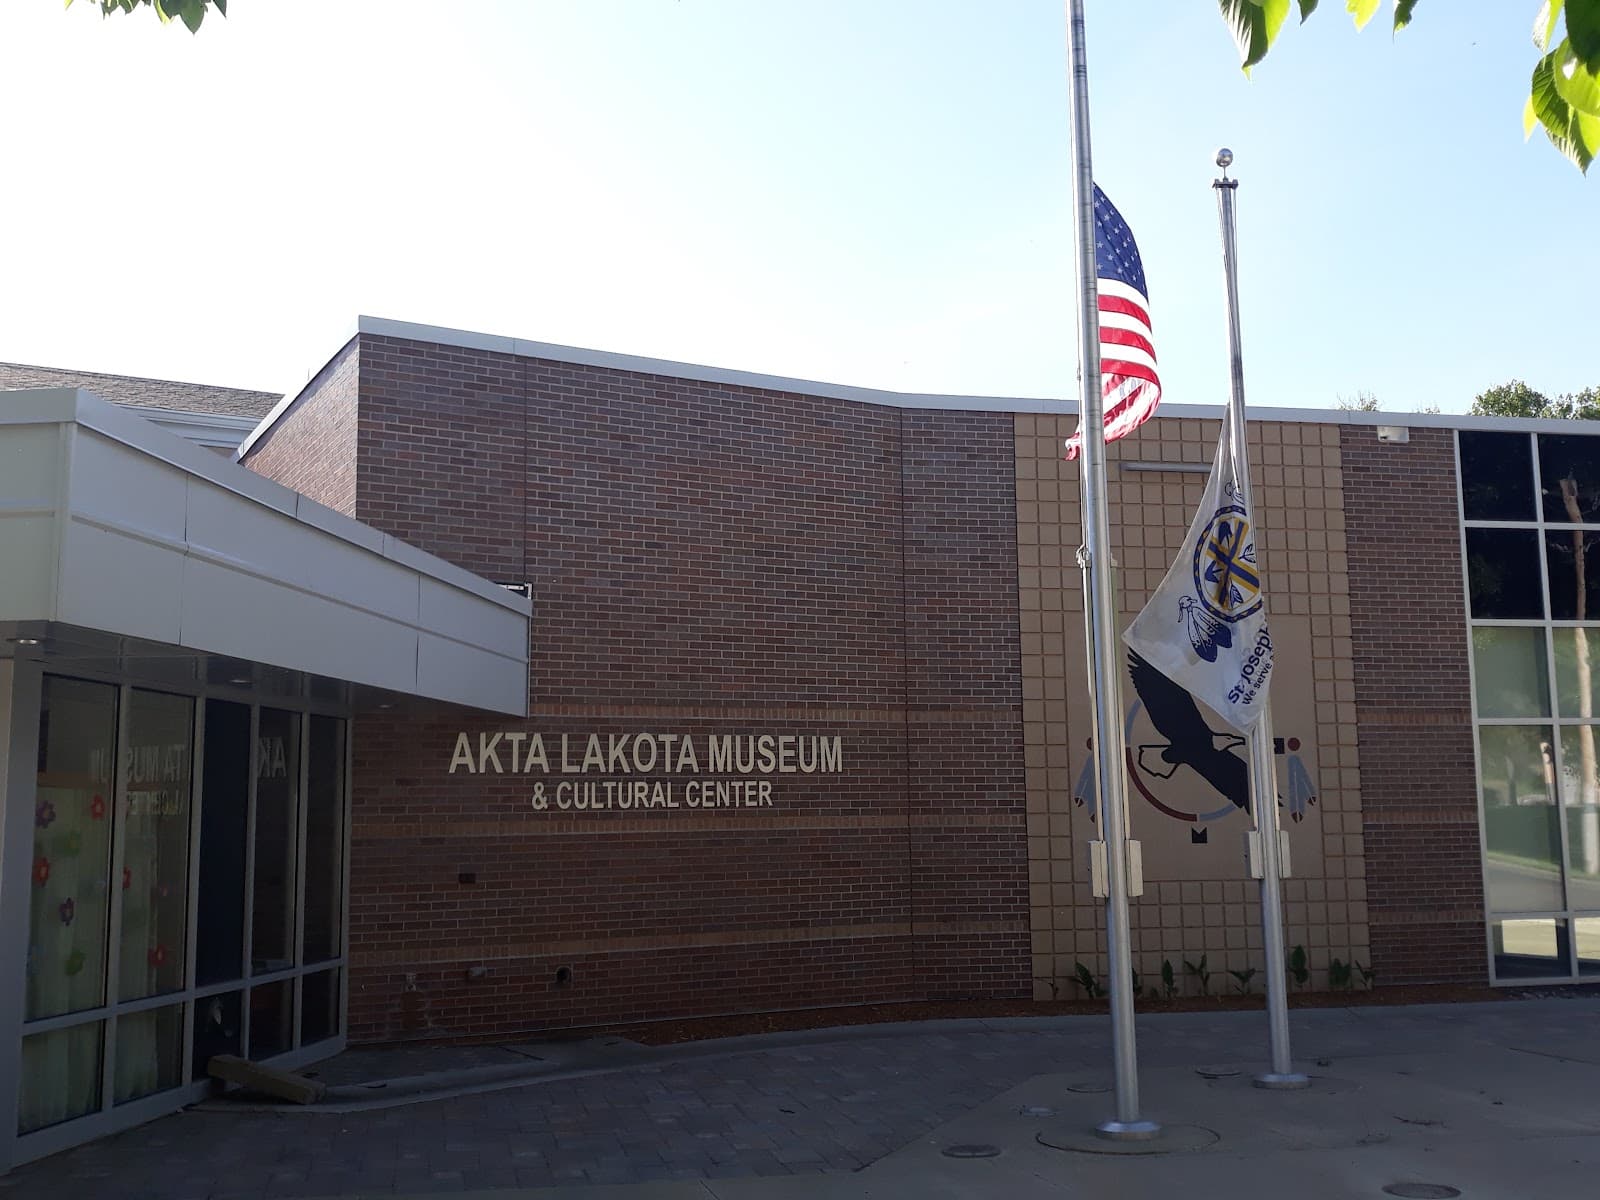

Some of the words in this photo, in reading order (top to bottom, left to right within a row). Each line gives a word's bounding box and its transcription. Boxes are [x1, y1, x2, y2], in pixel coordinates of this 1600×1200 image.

[1242, 690, 1257, 705] We
[1253, 662, 1273, 689] serve
[448, 731, 550, 774] AKTA
[561, 732, 699, 774] LAKOTA
[708, 734, 843, 774] MUSEUM
[532, 783, 549, 810] &
[556, 780, 680, 810] CULTURAL
[686, 780, 774, 808] CENTER
